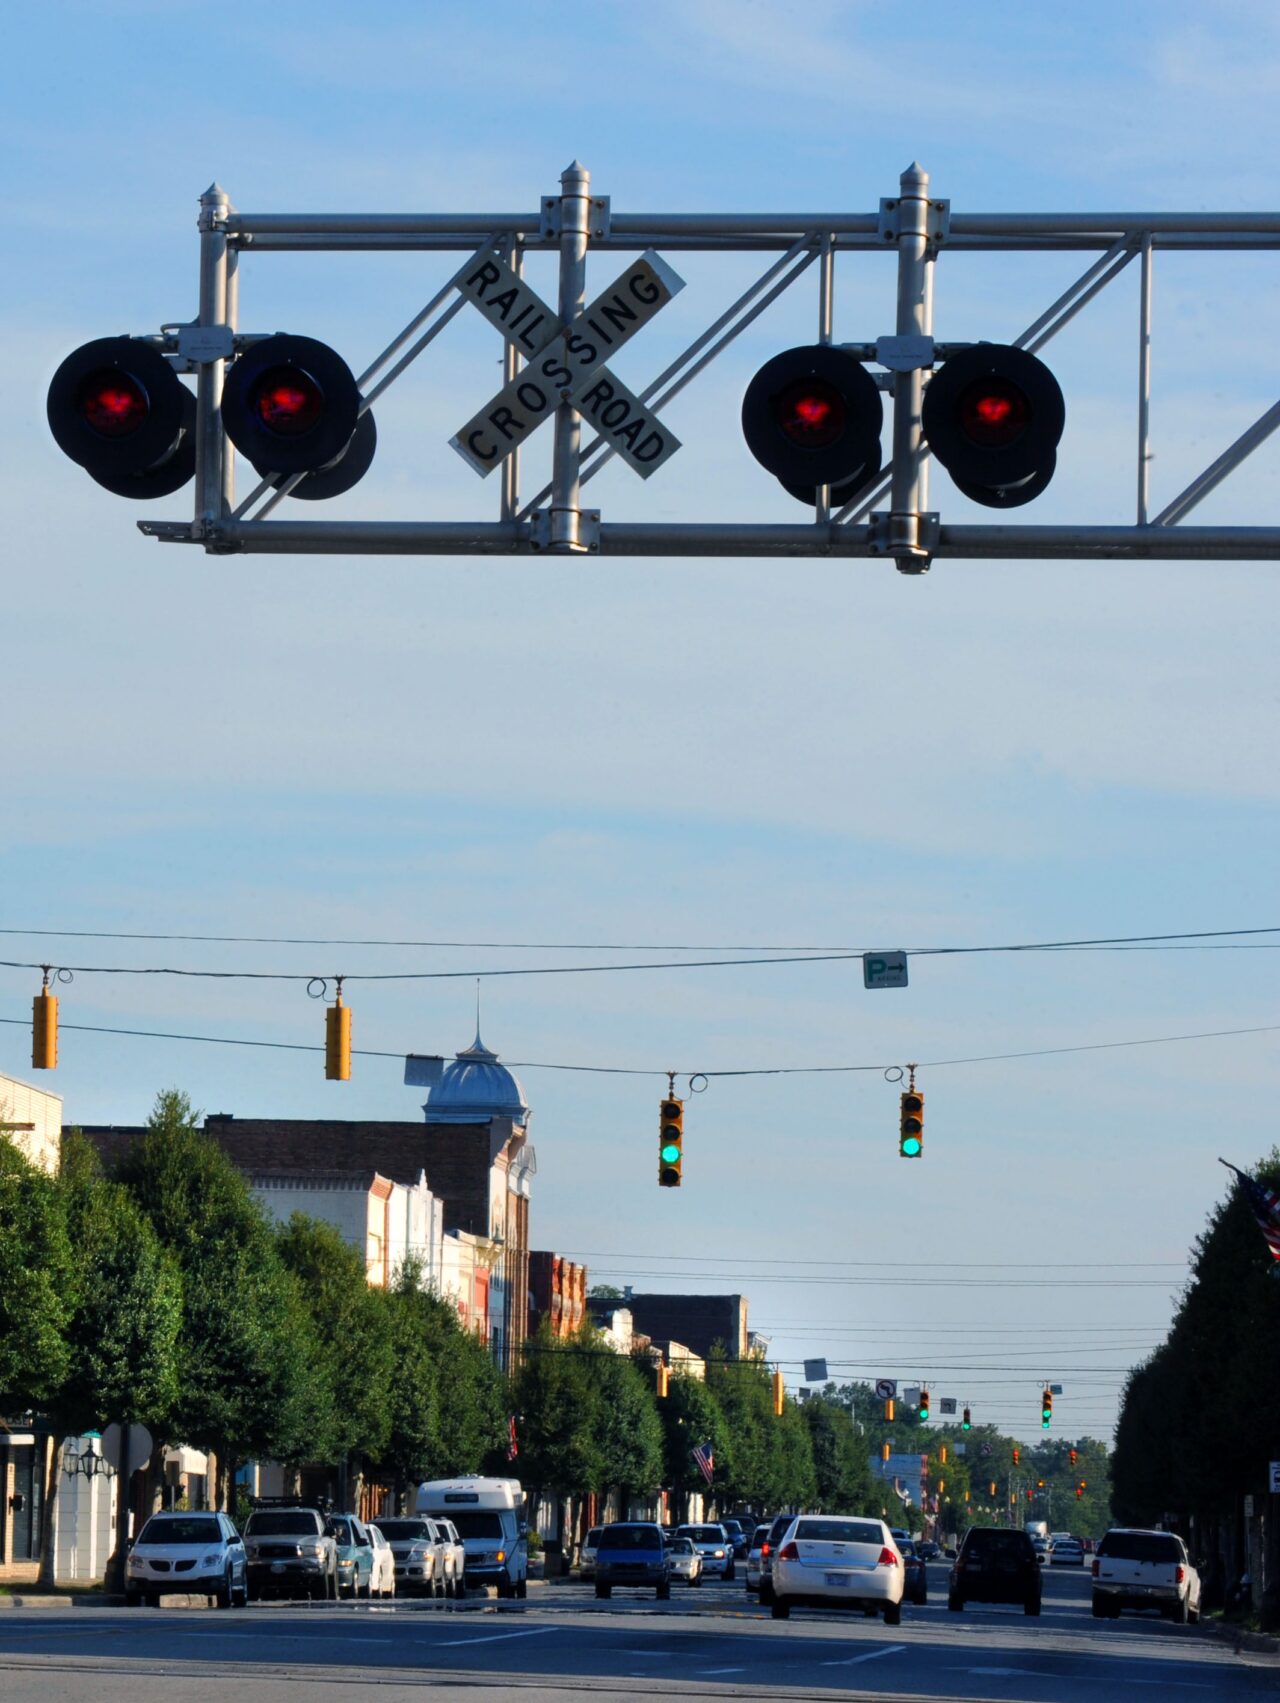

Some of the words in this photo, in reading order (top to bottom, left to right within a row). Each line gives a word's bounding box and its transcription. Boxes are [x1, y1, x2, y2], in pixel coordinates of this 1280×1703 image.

[466, 261, 545, 350] RAIL
[581, 379, 664, 463] ROAD
[468, 274, 660, 461] CROSSING
